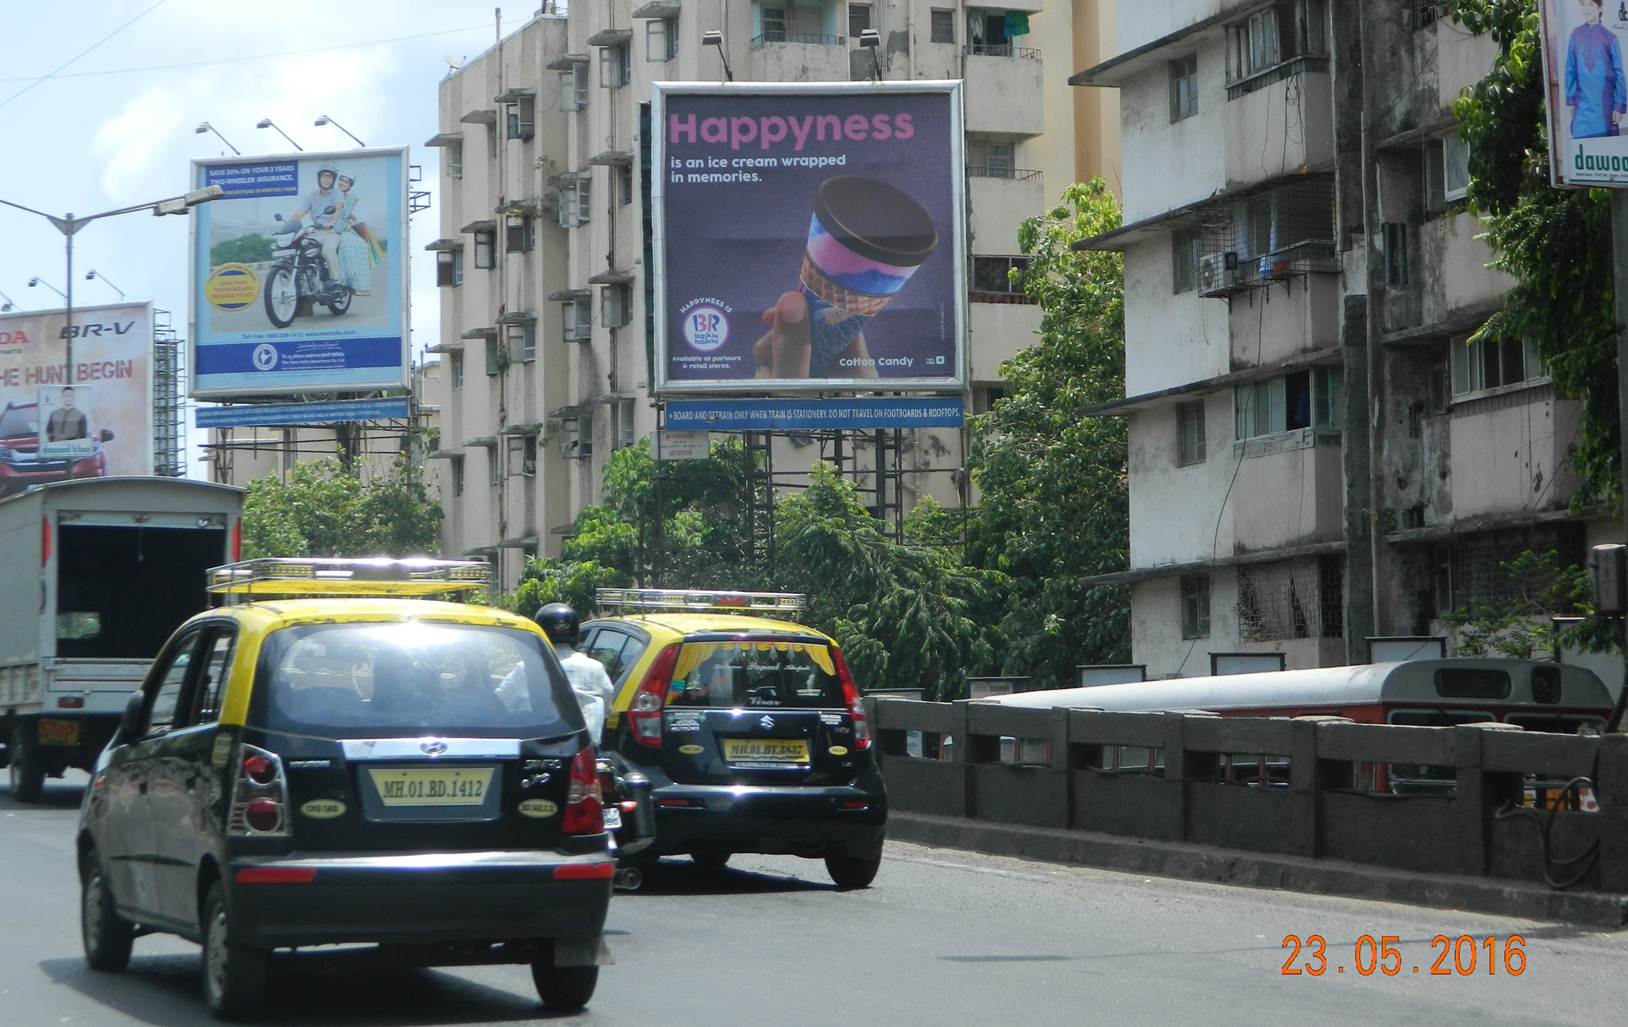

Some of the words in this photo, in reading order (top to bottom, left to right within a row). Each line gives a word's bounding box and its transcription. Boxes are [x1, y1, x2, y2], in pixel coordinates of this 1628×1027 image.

[670, 112, 915, 151] Happyness
[671, 156, 682, 169] is
[686, 158, 704, 169] an
[708, 155, 728, 168] ice
[732, 156, 778, 168] cream
[781, 154, 847, 168] wrapped
[671, 172, 684, 183] in
[688, 171, 762, 183] memories.
[59, 321, 136, 339] BR-V
[693, 313, 720, 331] BR
[77, 359, 132, 381] BEGIN
[840, 358, 875, 366] Cotton
[879, 356, 914, 367] Candy
[673, 411, 694, 420] BOARD
[694, 411, 706, 420] AND
[733, 411, 749, 420] ONLY
[749, 410, 767, 419] WHEN
[768, 410, 786, 418] TRAIN
[828, 409, 838, 418] DO
[838, 409, 851, 418] NOT
[852, 409, 873, 418] TRAVEL
[873, 408, 883, 417] ON
[883, 408, 922, 418] FOOTBOARDS
[383, 780, 483, 798] MH.01.BD.1412
